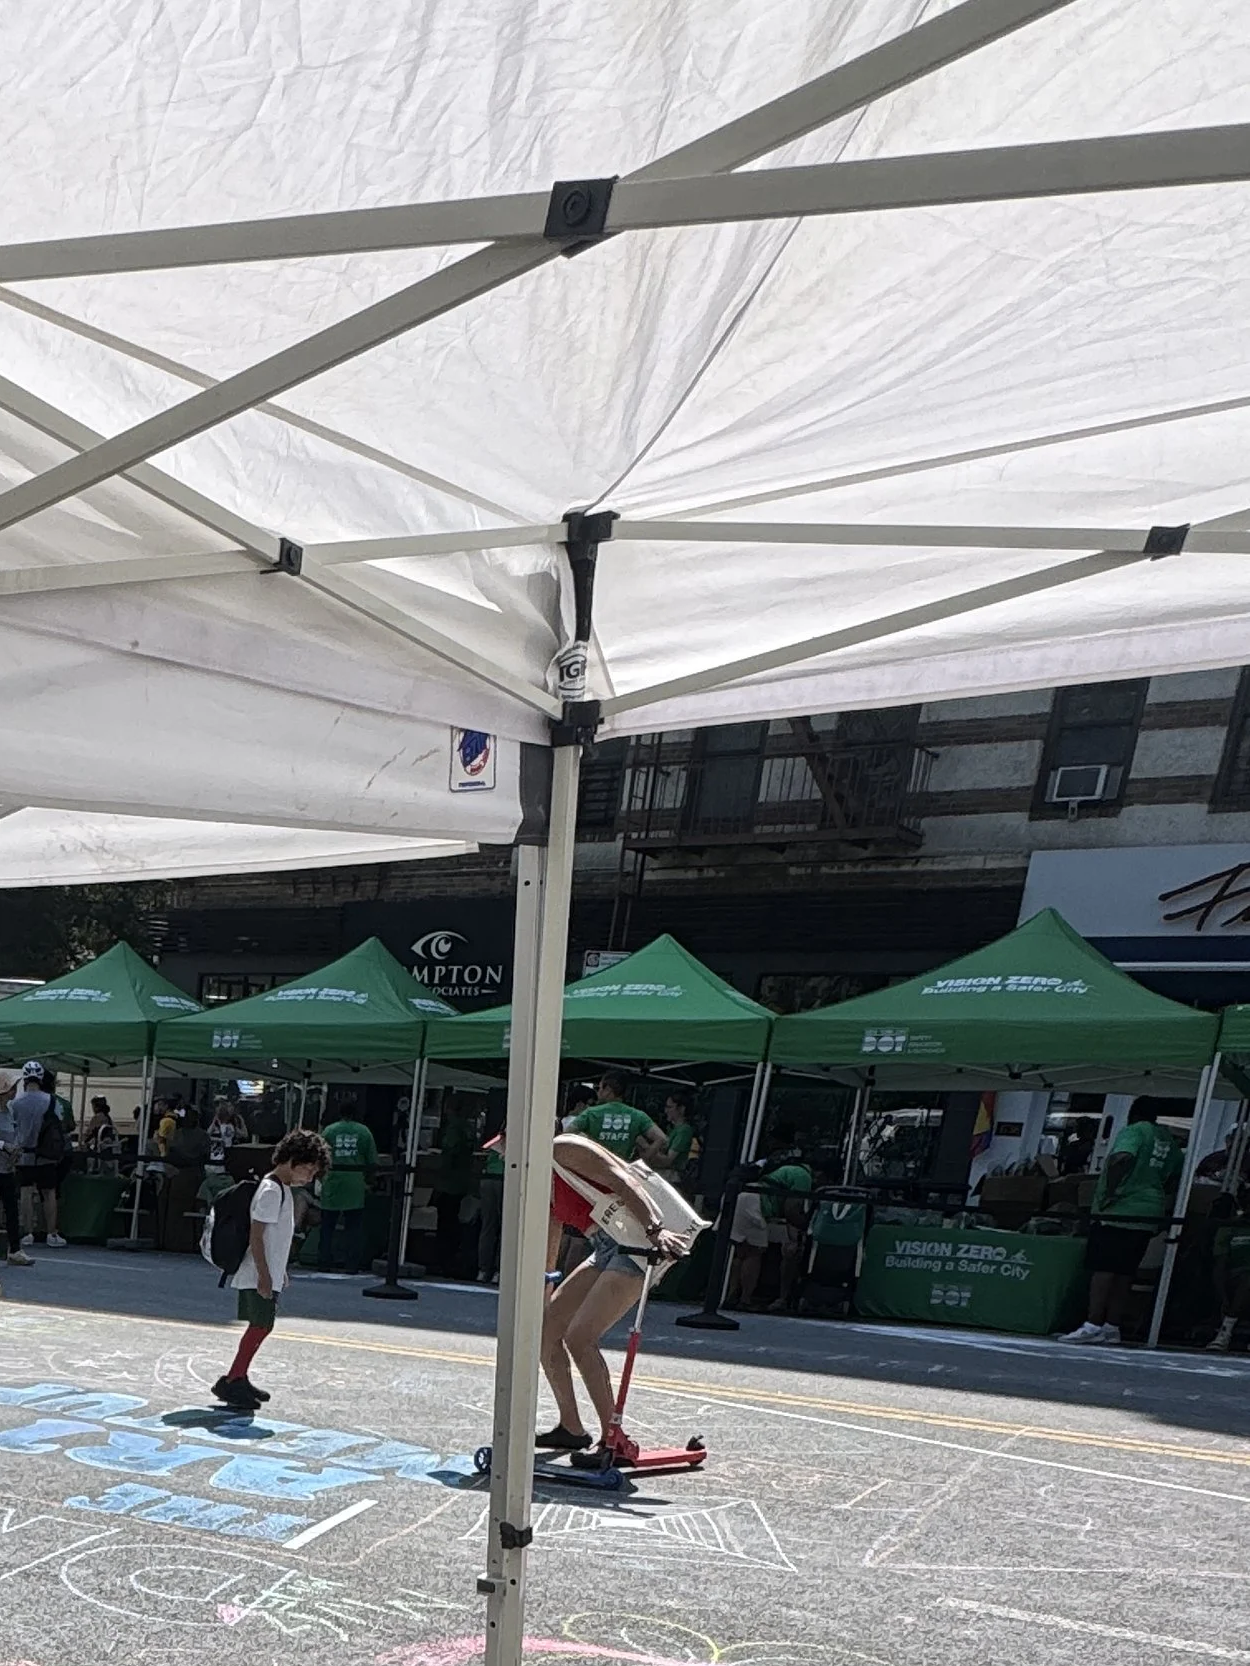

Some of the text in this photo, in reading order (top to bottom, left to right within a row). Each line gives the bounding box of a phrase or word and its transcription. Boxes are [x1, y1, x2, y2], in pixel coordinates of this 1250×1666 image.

[411, 964, 504, 986] MPTON
[935, 975, 1064, 988] VISION ZERO
[861, 1035, 908, 1053] DOT
[599, 1131, 631, 1142] STAFF
[894, 1240, 1008, 1261] VISION ZERO
[884, 1255, 1031, 1281] Building a Safer City
